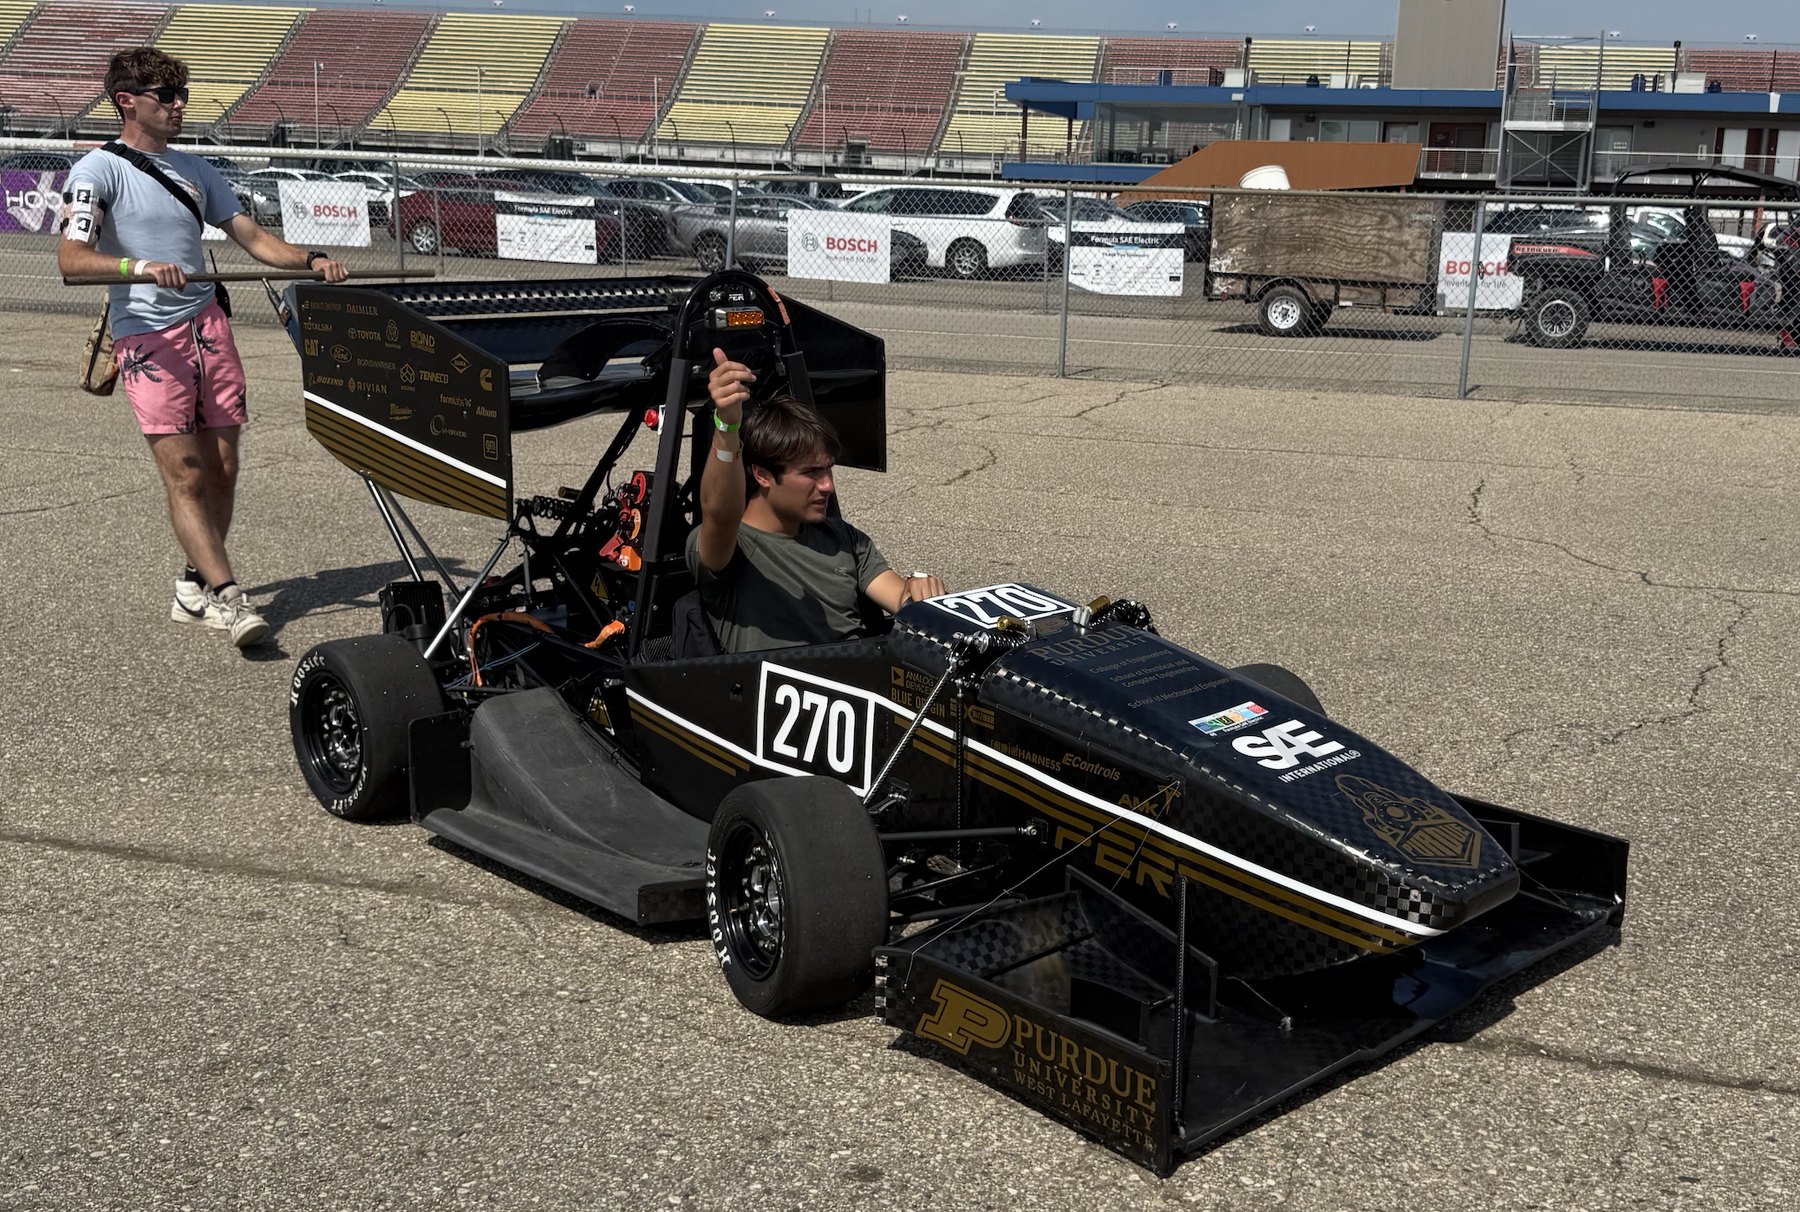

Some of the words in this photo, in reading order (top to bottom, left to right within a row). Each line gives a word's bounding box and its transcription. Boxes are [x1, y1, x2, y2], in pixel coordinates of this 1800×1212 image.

[313, 205, 358, 218] BOSCH
[826, 237, 878, 253] BOSCH
[1090, 235, 1119, 244] Formula
[1120, 236, 1133, 244] SAE
[1134, 236, 1161, 245] Electric
[1445, 260, 1508, 276] BOCH
[346, 303, 379, 317] DAIMLER
[357, 329, 382, 341] TOYOTA
[410, 330, 435, 348] BOND
[304, 338, 319, 357] CAT
[316, 375, 344, 387] BOEING
[418, 369, 449, 385] TENNECO
[356, 381, 388, 395] RIVIAN
[942, 587, 1058, 624] 270
[905, 671, 934, 687] ANALOG
[891, 688, 913, 707] BLUE
[915, 697, 945, 719] ORGIN
[773, 683, 856, 774] 270
[1231, 719, 1346, 770] SAE
[990, 739, 1062, 773] rapidHARNESS
[1062, 752, 1122, 782] EControls
[1117, 793, 1159, 817] AMK
[915, 978, 1012, 1056] P
[1012, 1014, 1157, 1113] PURDUE
[1013, 1050, 1156, 1132] UNIVERSITY
[1014, 1068, 1056, 1100] WEST
[1062, 1094, 1155, 1152] LAFAYETTE
